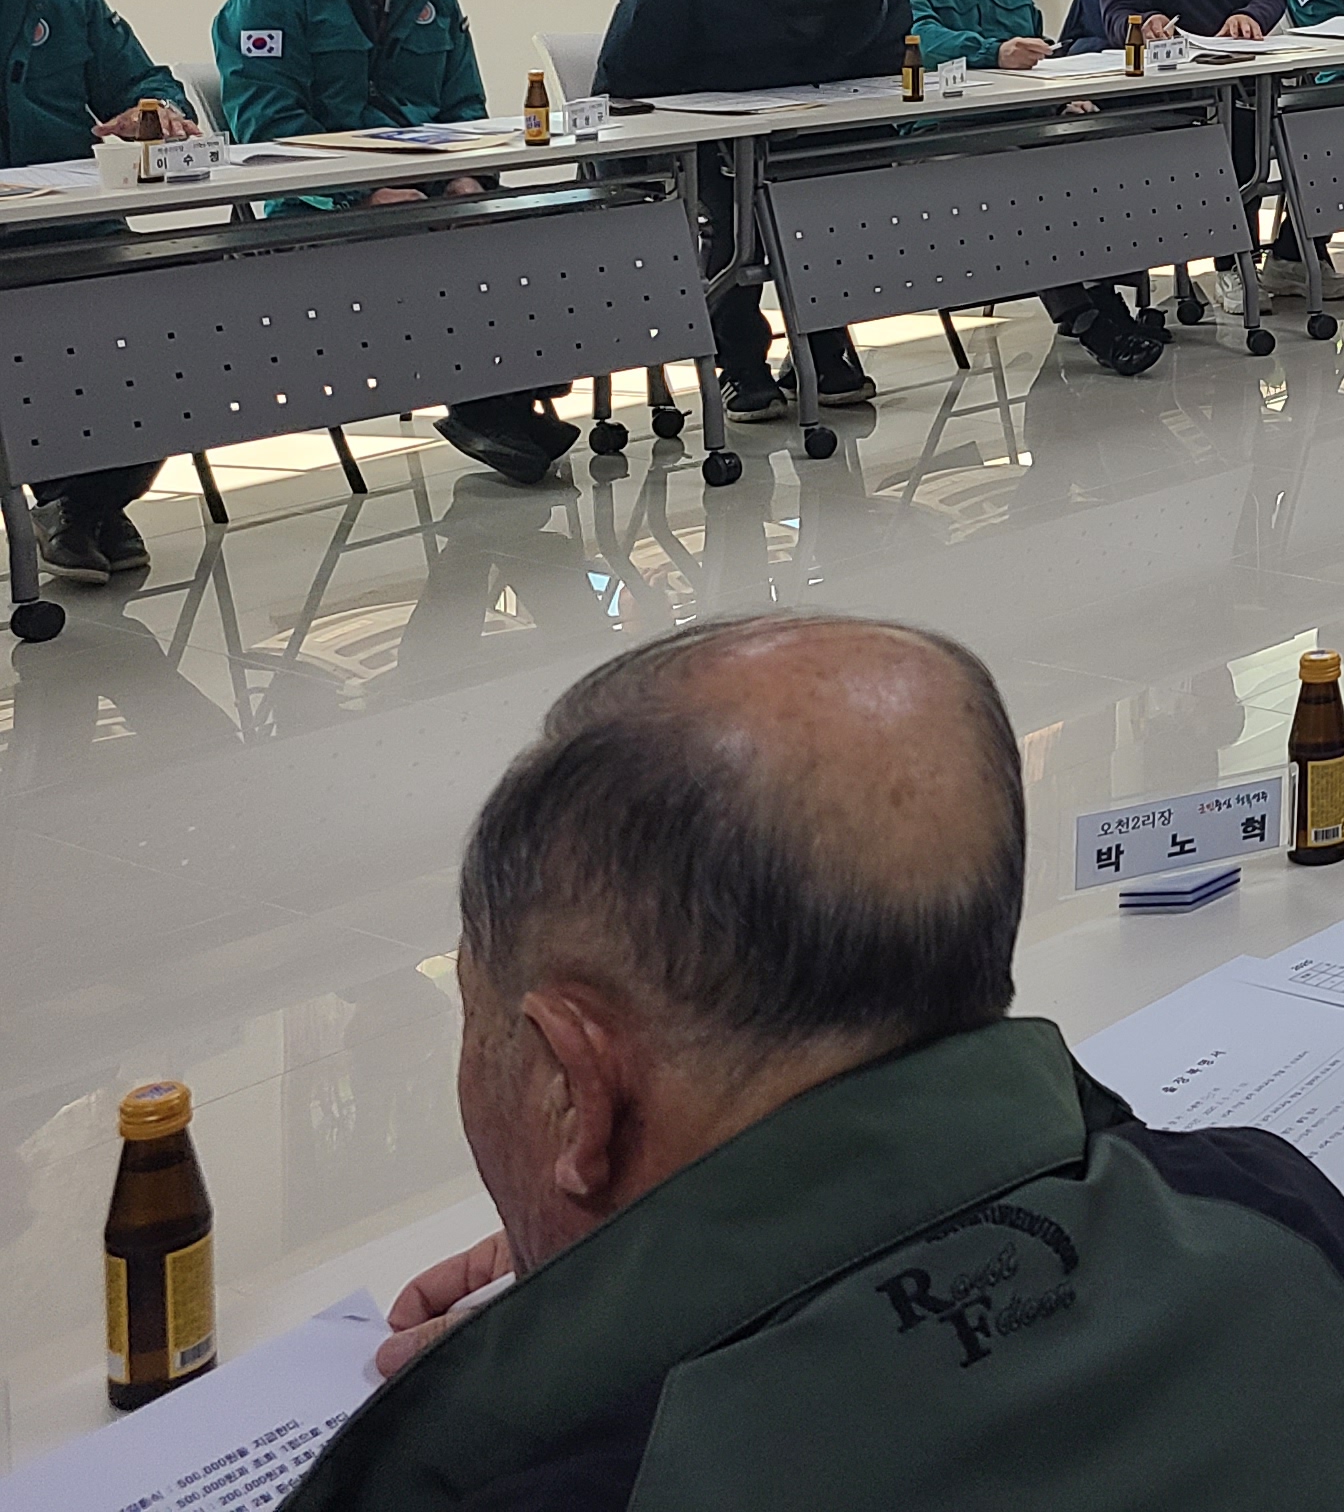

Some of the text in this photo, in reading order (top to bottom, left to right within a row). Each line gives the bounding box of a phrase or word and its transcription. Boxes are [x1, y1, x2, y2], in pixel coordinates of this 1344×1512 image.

[1095, 813, 1267, 873] 박 노 혁
[1097, 807, 1175, 838] 오천2리장
